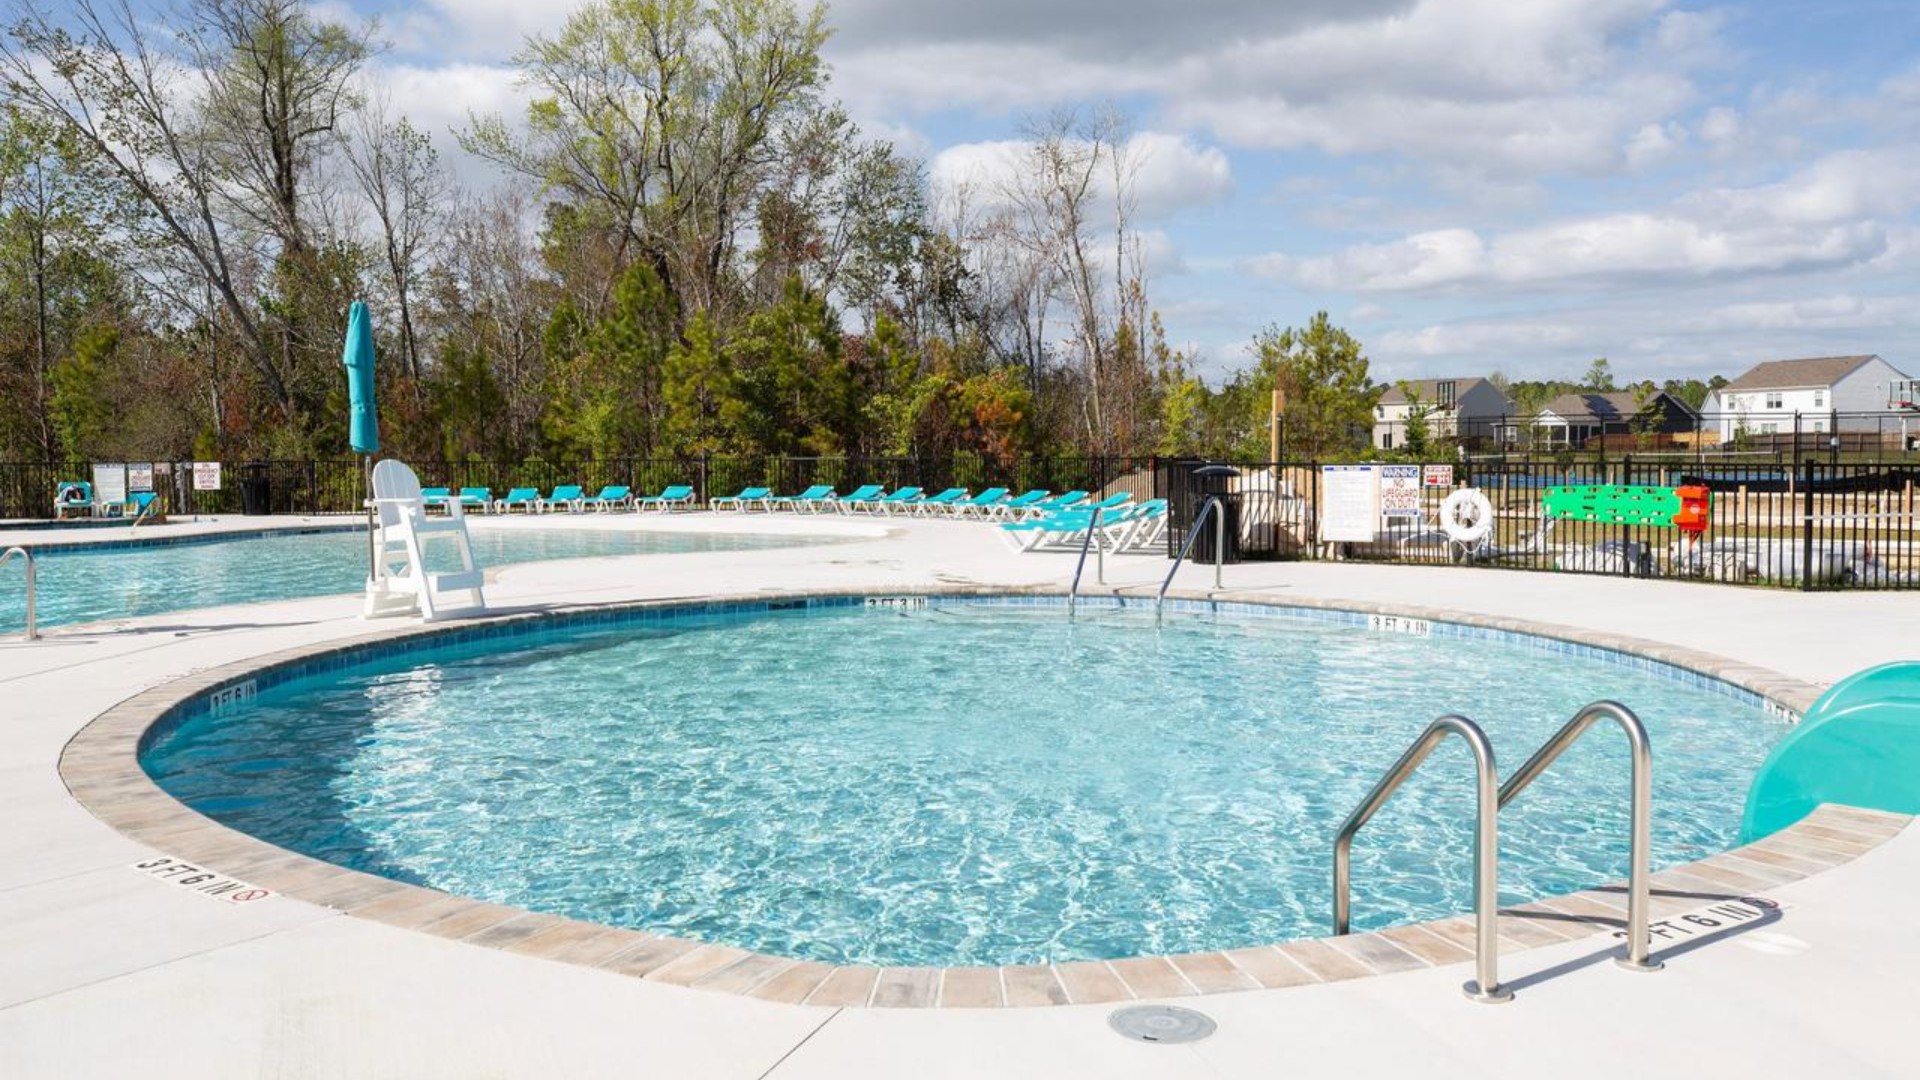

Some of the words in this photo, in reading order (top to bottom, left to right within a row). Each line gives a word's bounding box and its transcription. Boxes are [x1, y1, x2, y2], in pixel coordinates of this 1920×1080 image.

[1382, 467, 1418, 477] WARNING
[1393, 479, 1405, 488] NO
[1382, 488, 1418, 498] LIFEGUARD
[1384, 499, 1396, 508] ON
[1397, 499, 1416, 508] DUTY
[137, 858, 172, 869] 3
[150, 864, 199, 878] FT
[179, 873, 216, 885] 6
[197, 880, 246, 896] IN
[1648, 921, 1694, 940] FT
[1681, 914, 1723, 928] 6
[1707, 904, 1761, 921] IN
